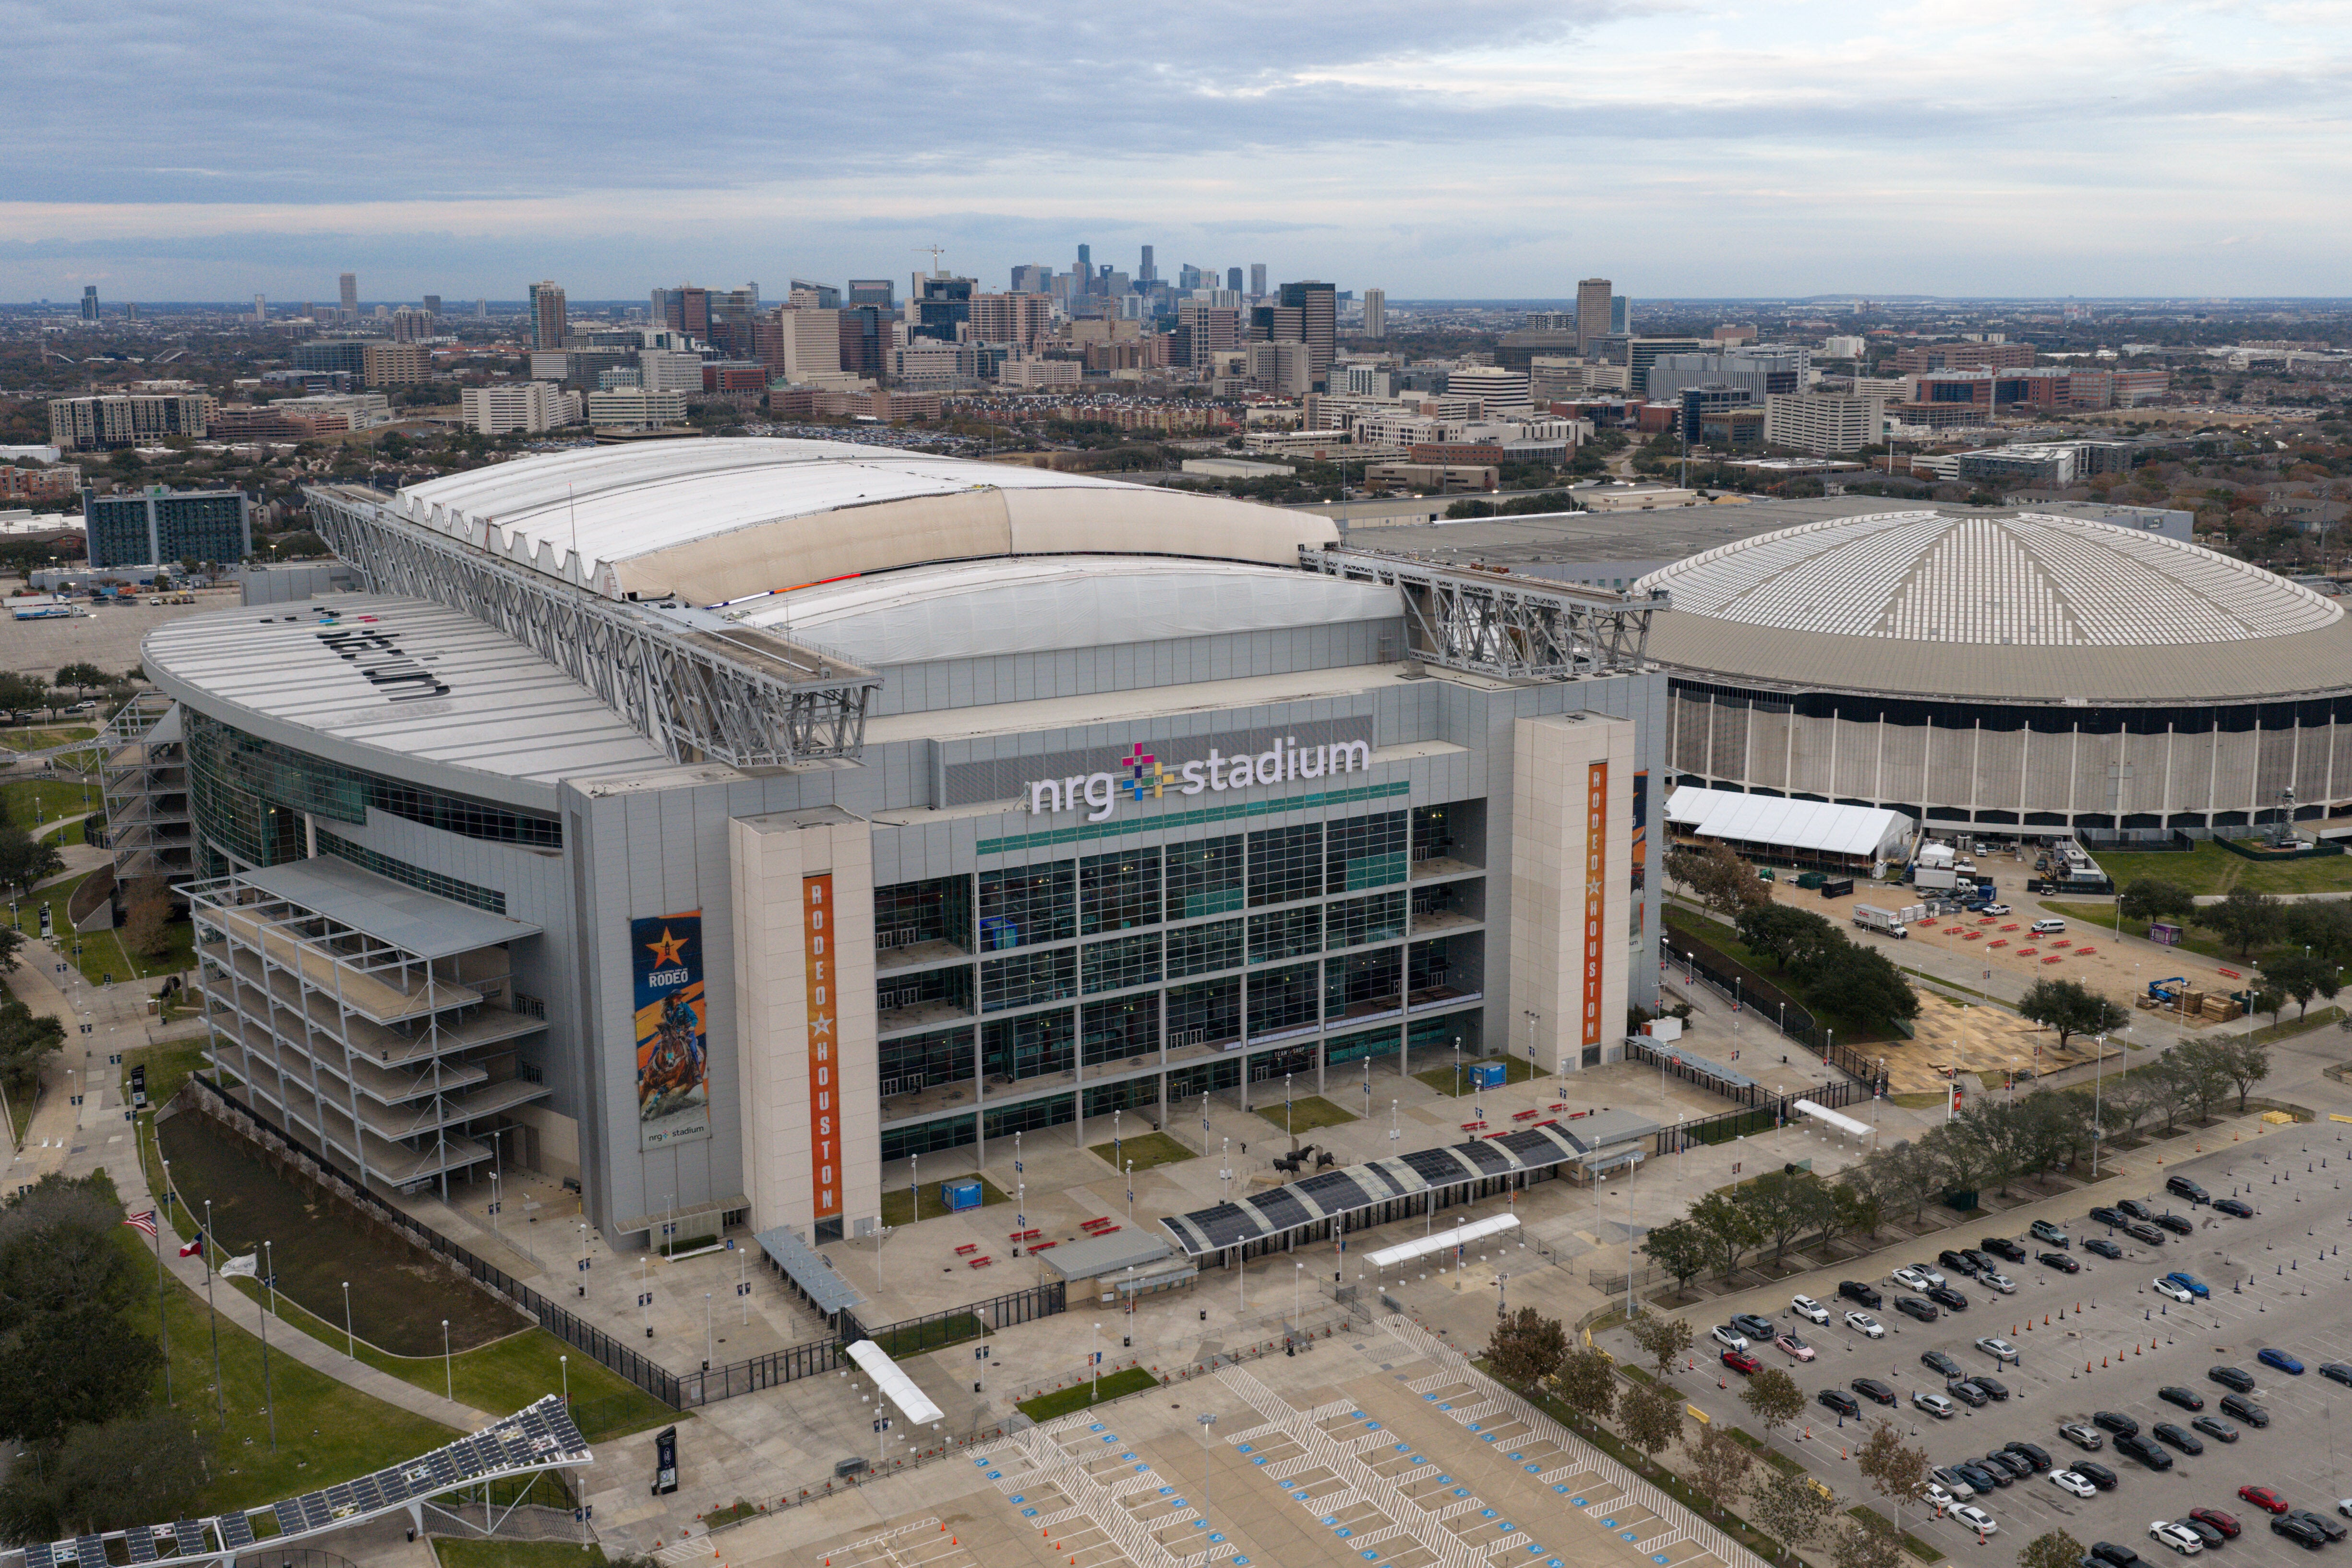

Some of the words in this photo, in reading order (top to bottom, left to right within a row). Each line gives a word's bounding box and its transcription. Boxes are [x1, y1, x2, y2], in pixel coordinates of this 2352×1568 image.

[1031, 771, 1114, 821] nrg
[1180, 736, 1369, 794] stadium
[1591, 771, 1600, 871] RODEO
[649, 971, 688, 988] RODEO
[812, 885, 825, 1005] RODEO
[1587, 901, 1597, 1038] HOUSTON
[672, 1126, 704, 1137] stadium
[818, 1042, 832, 1209] HOUSTON
